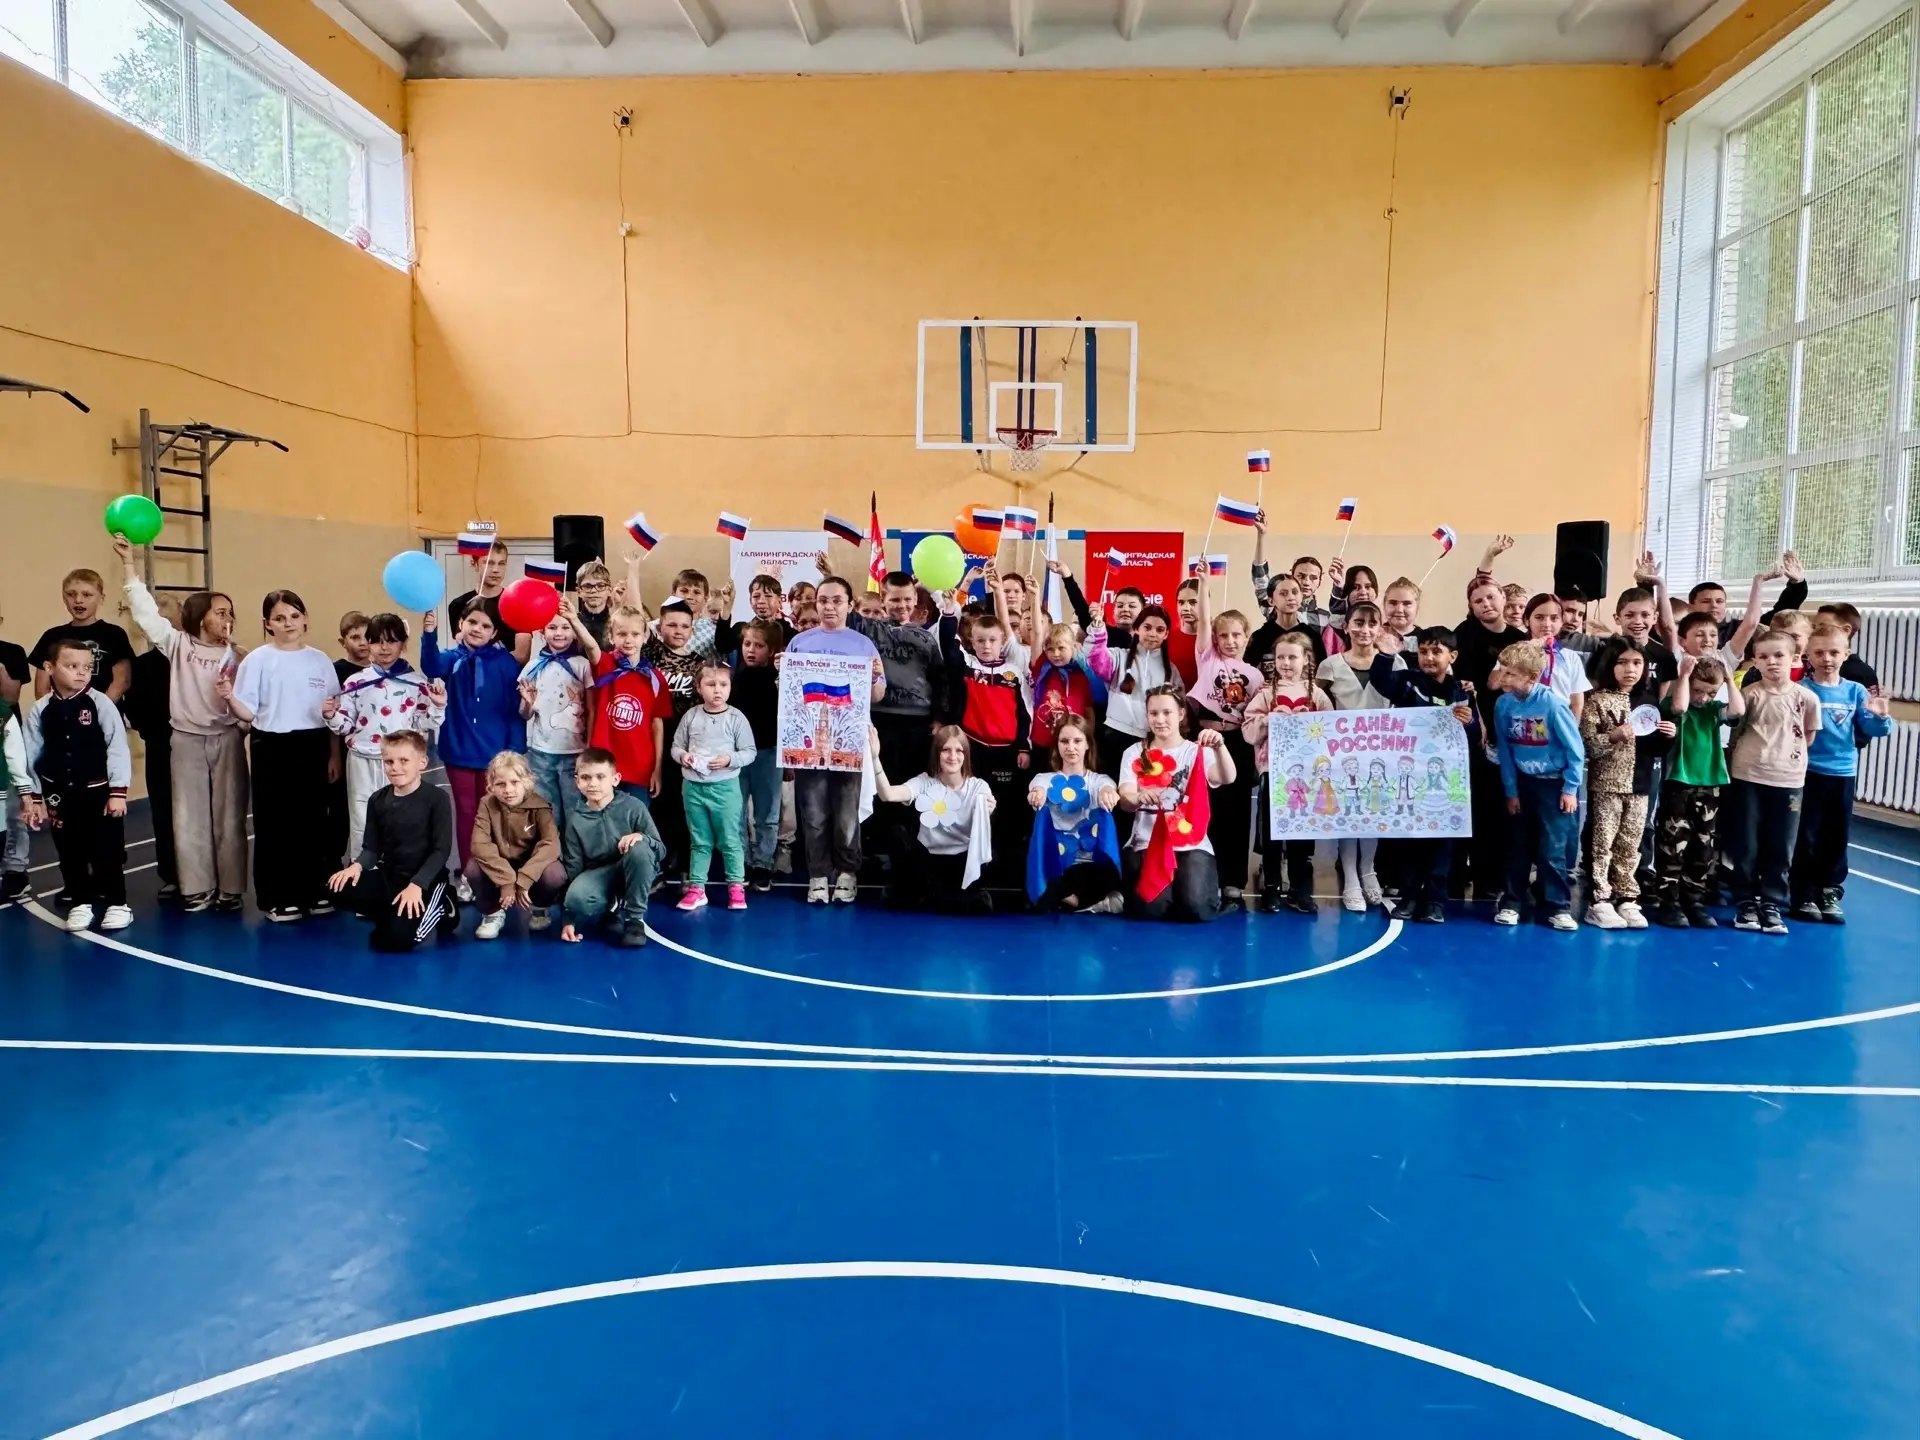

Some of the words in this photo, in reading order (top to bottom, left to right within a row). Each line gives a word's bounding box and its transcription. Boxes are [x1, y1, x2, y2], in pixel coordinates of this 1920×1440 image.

[468, 522, 495, 530] ЫХОД
[787, 658, 805, 668] День
[839, 661, 847, 669] 12
[1335, 717, 1349, 734] С
[1352, 713, 1406, 734] ДНЁМ
[1327, 734, 1418, 757] РОССИИ!
